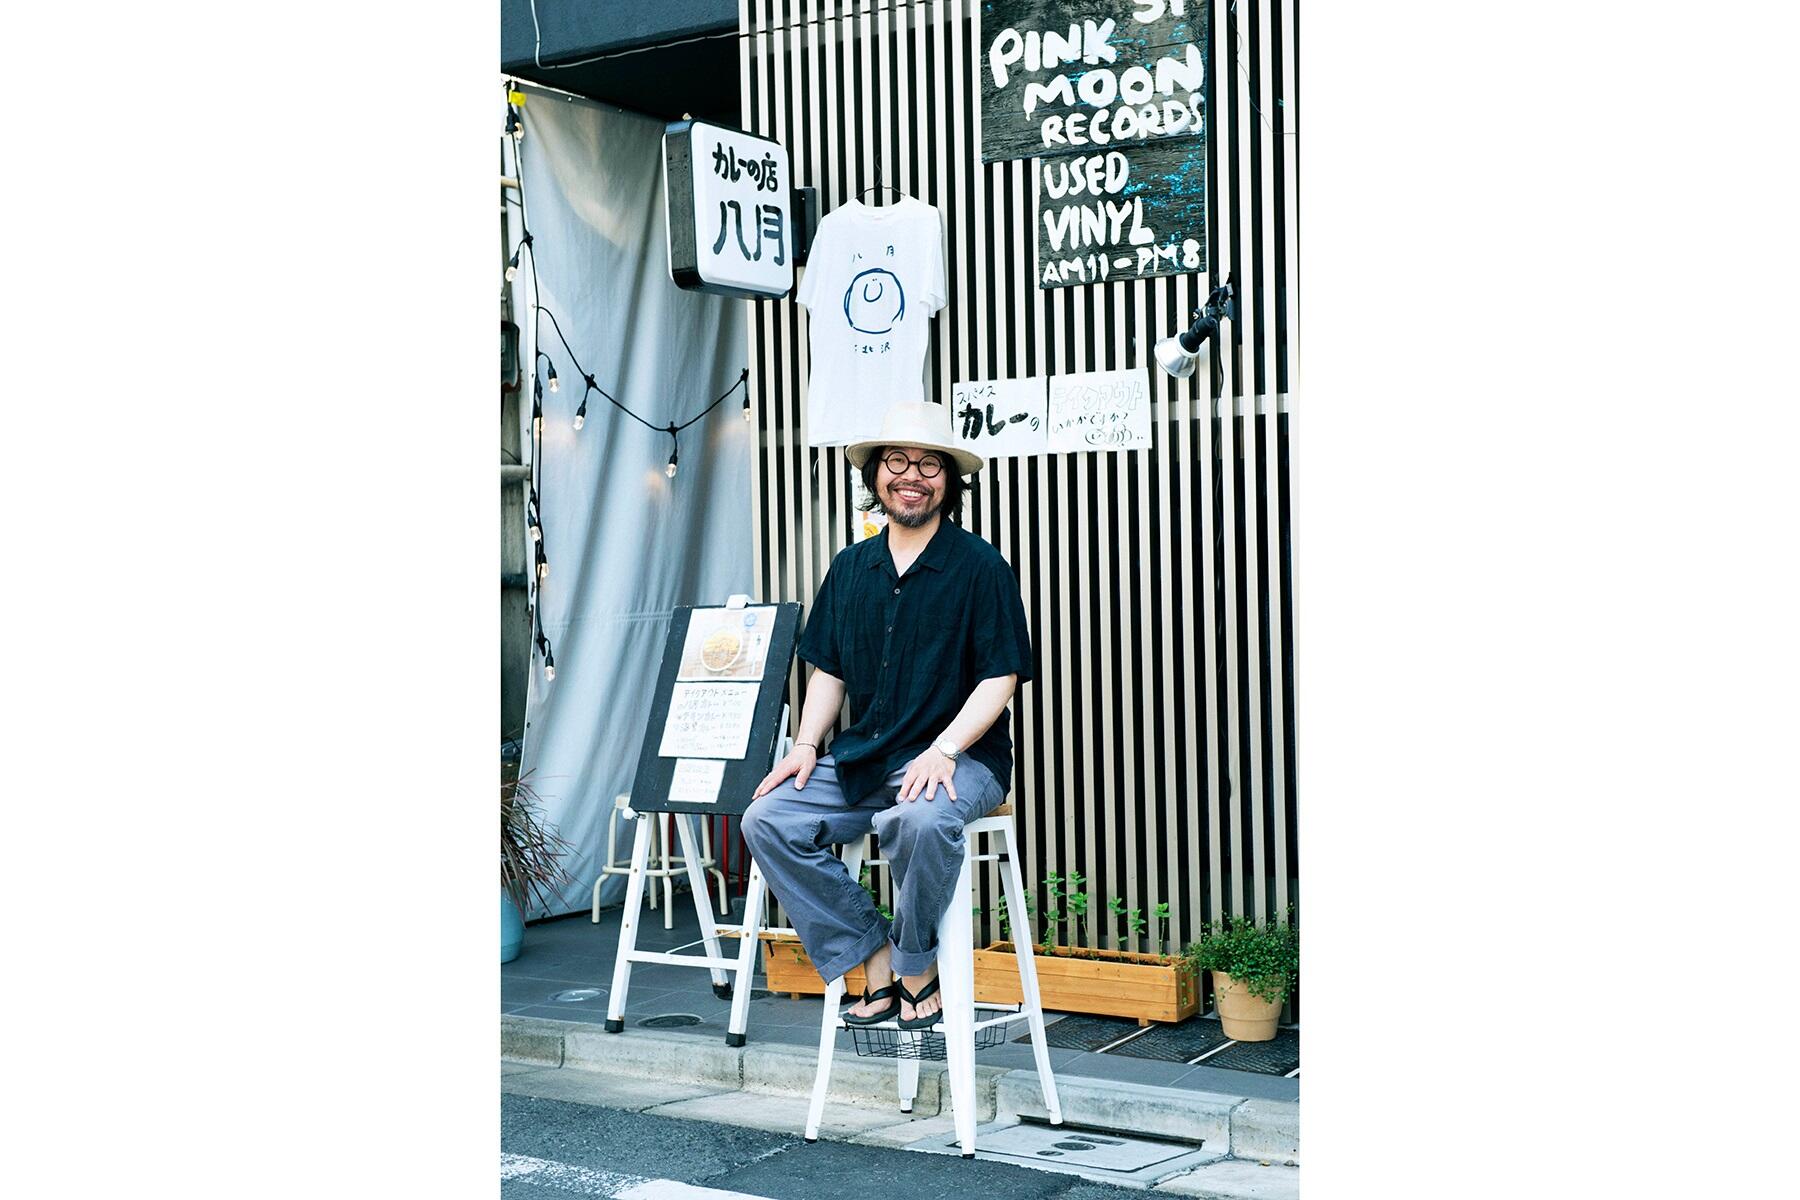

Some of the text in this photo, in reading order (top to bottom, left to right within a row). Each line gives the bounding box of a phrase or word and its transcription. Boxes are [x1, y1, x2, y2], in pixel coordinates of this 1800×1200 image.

[989, 18, 1117, 88] PINK
[1023, 43, 1204, 120] MOON
[1041, 92, 1205, 148] RECORDS
[712, 142, 778, 192] カレーの店
[1044, 151, 1129, 199] USED
[713, 200, 785, 267] 八月
[1043, 196, 1155, 251] VINYL
[1052, 381, 1143, 413] テイクアウト
